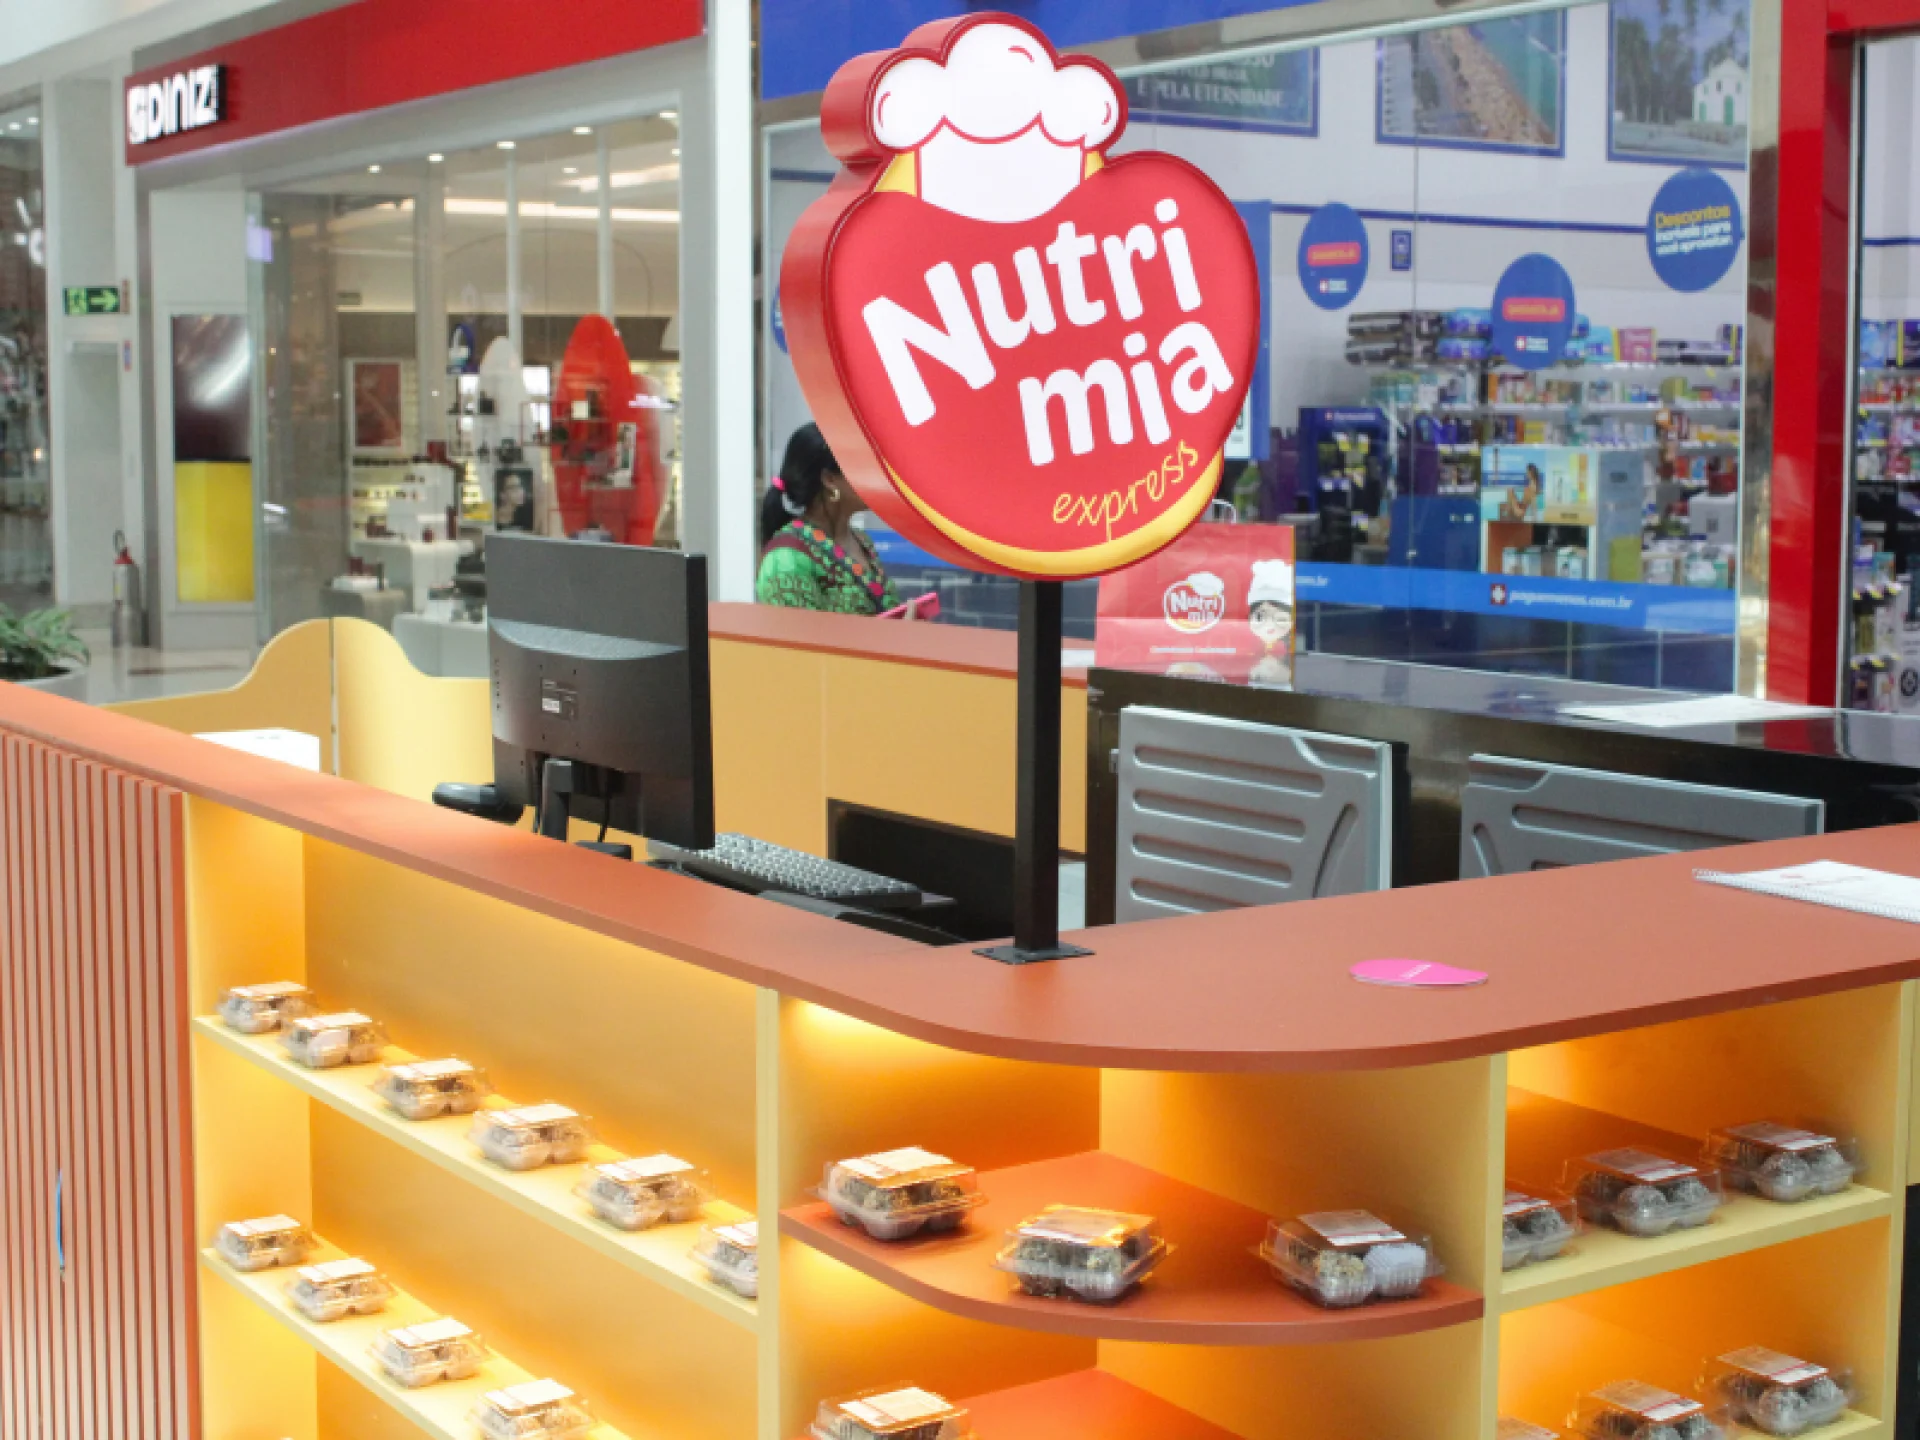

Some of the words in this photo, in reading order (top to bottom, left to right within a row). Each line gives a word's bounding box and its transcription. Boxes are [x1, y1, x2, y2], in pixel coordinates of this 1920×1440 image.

[862, 199, 1202, 426] Nutri
[1018, 321, 1234, 466] mia
[1052, 440, 1199, 541] express
[1170, 590, 1218, 613] Nutri
